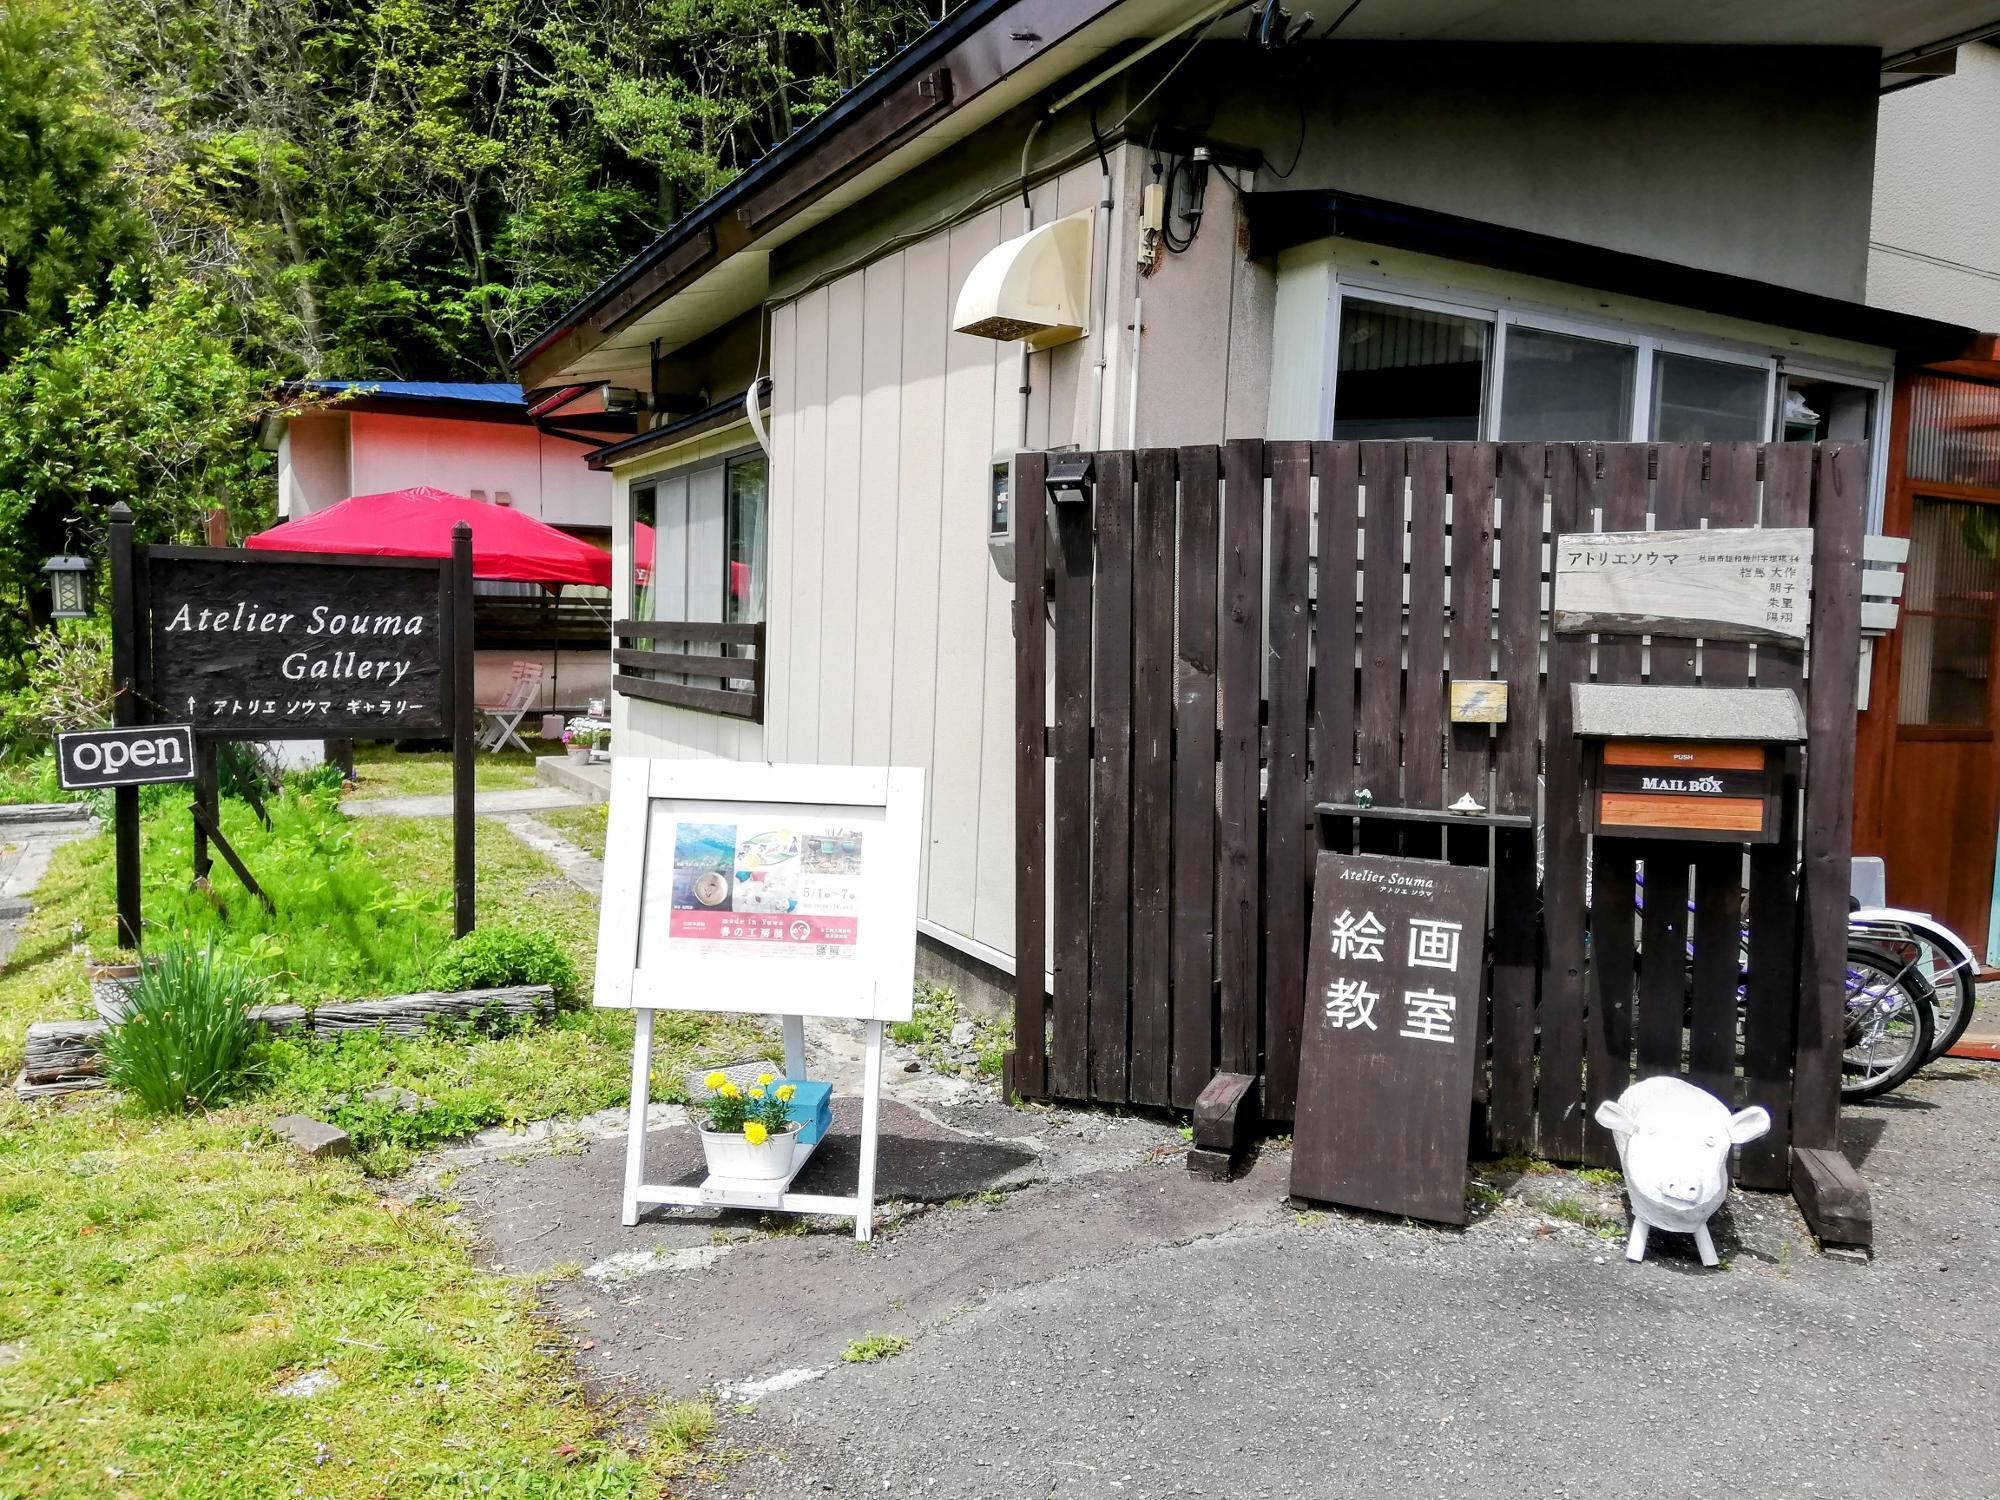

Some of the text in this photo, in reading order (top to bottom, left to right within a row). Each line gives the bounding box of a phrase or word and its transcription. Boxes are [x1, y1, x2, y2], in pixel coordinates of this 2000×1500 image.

[1567, 552, 1680, 567] アトリエソウマ
[1770, 567, 1798, 579] 大作
[1768, 582, 1796, 594] 朋子
[1767, 597, 1794, 609] 朱里
[165, 602, 424, 636] Atelier Souma
[1765, 611, 1793, 624] 陽翔
[281, 652, 411, 687] Gallery
[213, 698, 424, 716] アトリエ ソウマ ギャラリー
[72, 735, 183, 776] open
[1673, 753, 1694, 761] PUSH
[1642, 777, 1723, 793] MAIL BOX
[1339, 868, 1434, 888] Atelier Souma
[1379, 886, 1408, 896] アトリエ
[721, 917, 745, 926] made
[748, 918, 757, 926] in
[720, 926, 784, 938] 春の工房展
[1330, 907, 1463, 973] 絵画
[1326, 977, 1457, 1044] 教室
